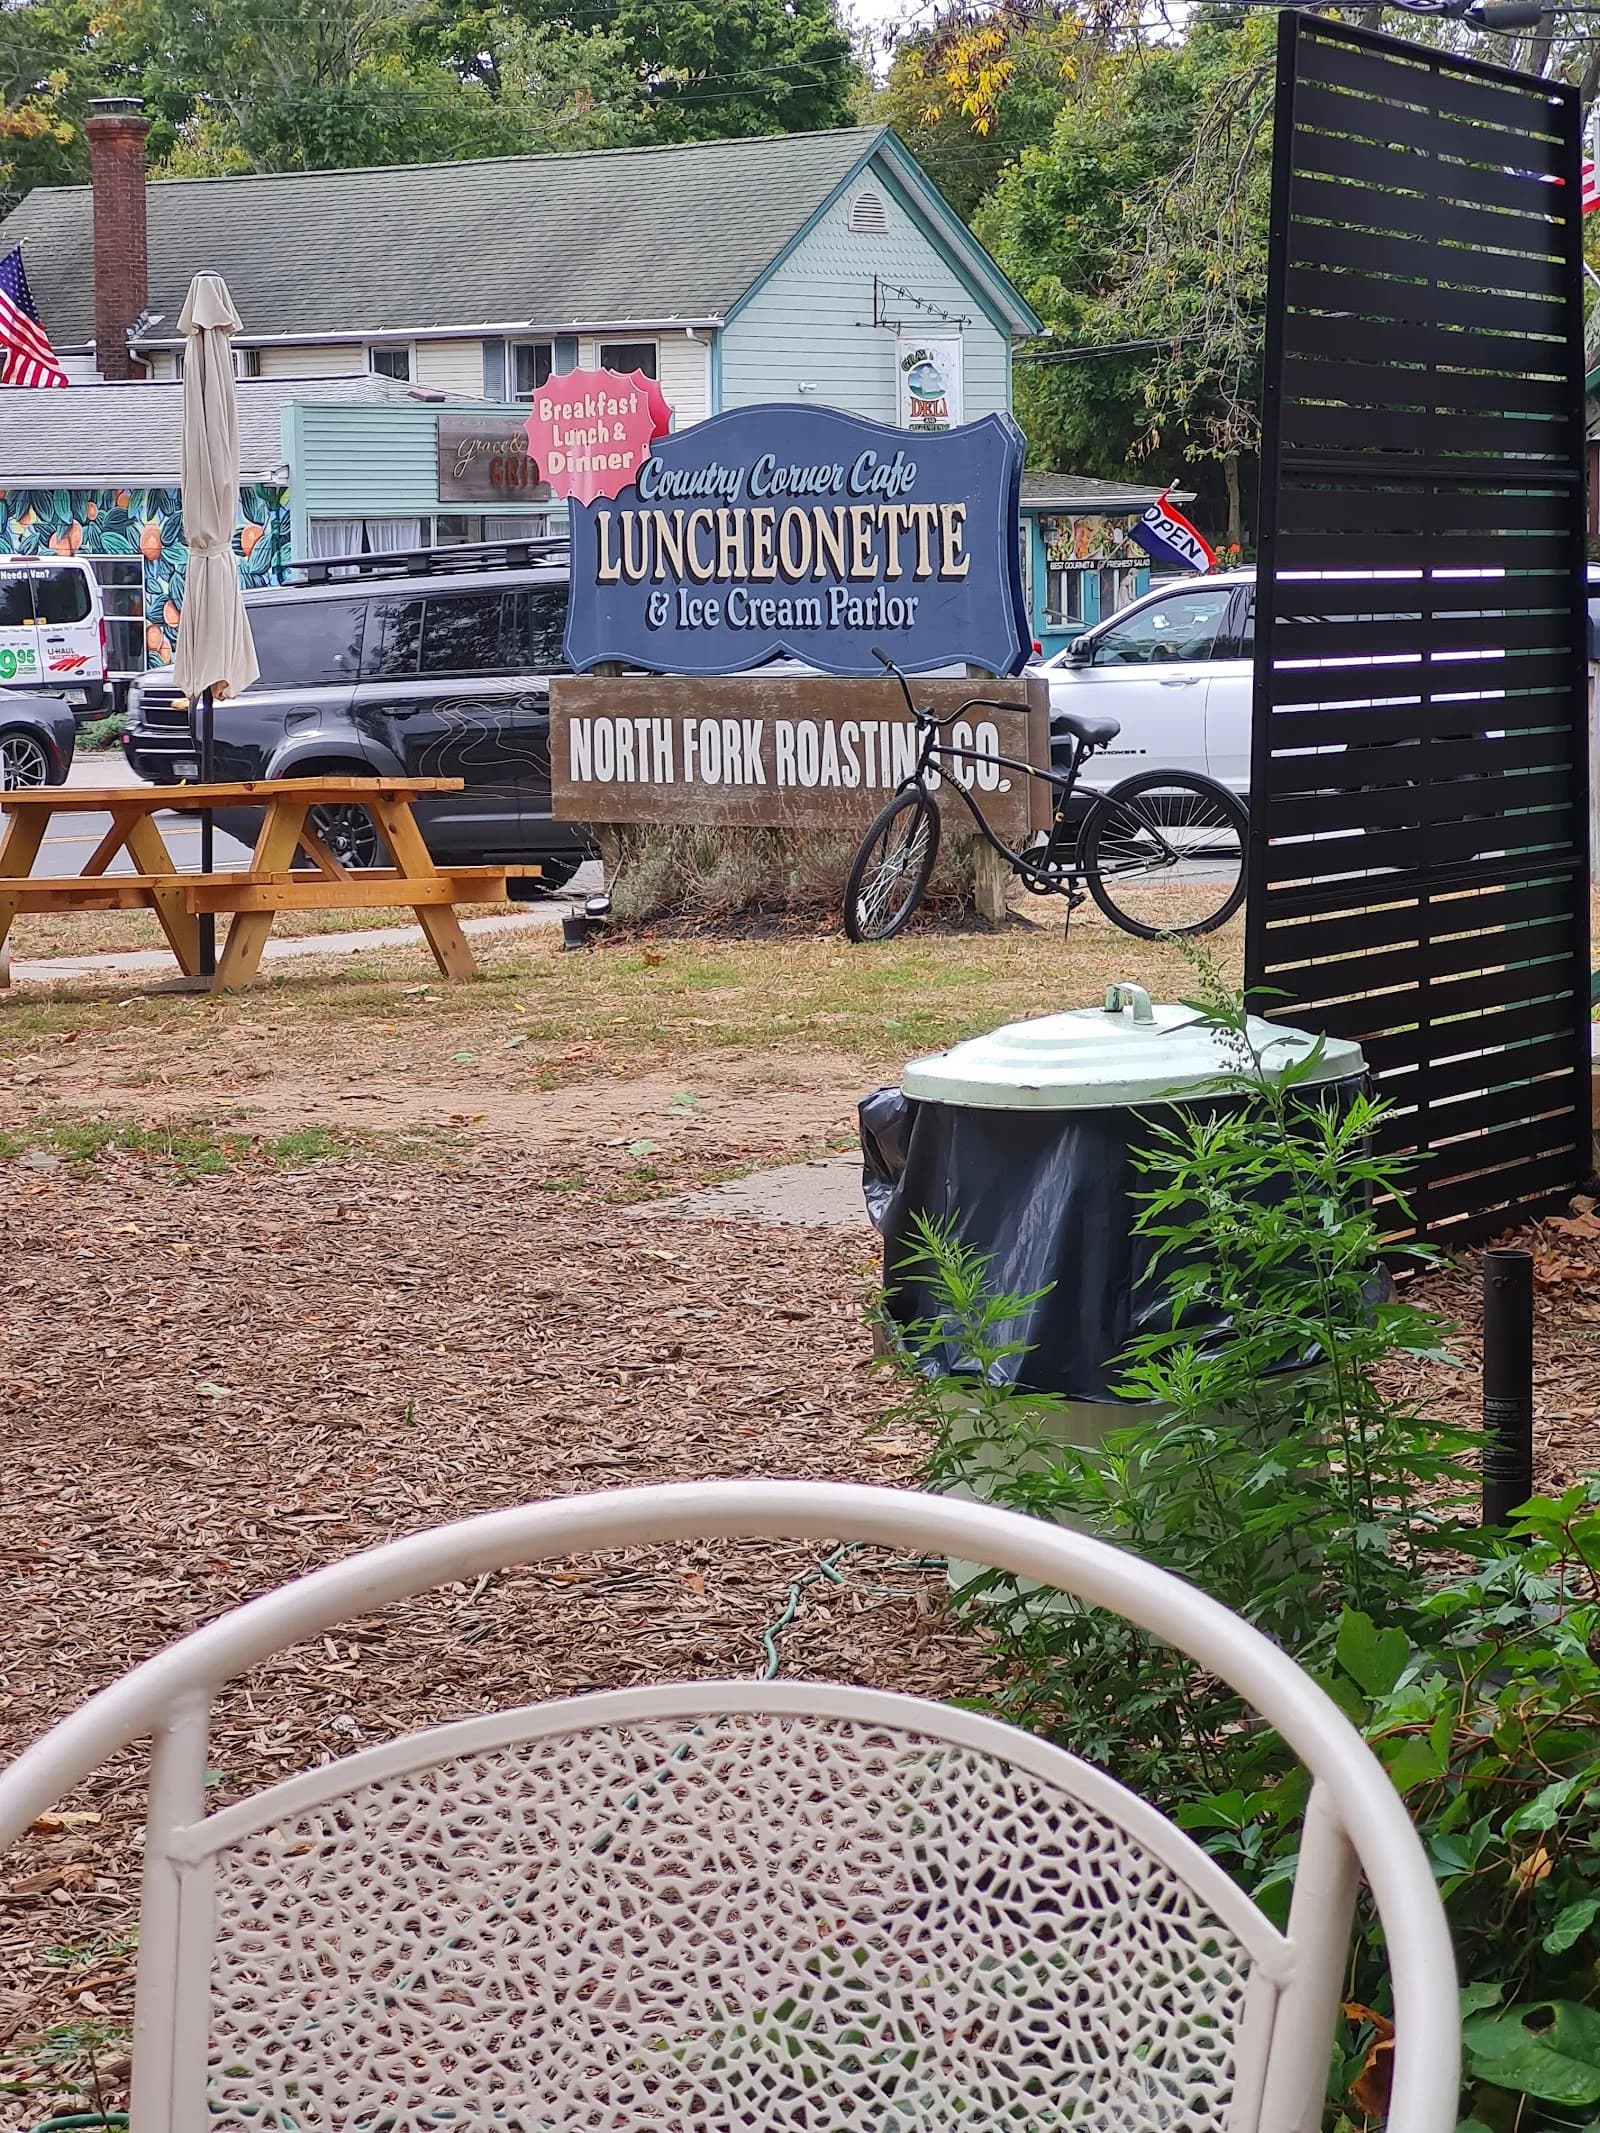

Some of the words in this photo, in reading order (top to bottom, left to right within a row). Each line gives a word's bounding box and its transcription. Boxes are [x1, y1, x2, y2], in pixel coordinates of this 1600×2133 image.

[539, 391, 638, 422] Breakfast
[911, 397, 948, 417] DELI
[552, 420, 609, 448] Lunch
[613, 422, 627, 441] &
[547, 451, 634, 475] Dinner
[639, 456, 746, 502] Country
[750, 453, 845, 496] Corner
[850, 450, 917, 498] Cafe
[597, 503, 971, 580] LUNCHEONETTE
[1142, 505, 1202, 559] OPEN
[0, 570, 22, 580] Need
[22, 571, 28, 579] a
[30, 569, 50, 579] Van?
[648, 591, 670, 627] &
[679, 587, 720, 627] Ice
[727, 586, 822, 627] Cream
[828, 585, 919, 627] Parlor
[569, 717, 674, 784] NORTH
[682, 718, 767, 785] FORK
[952, 720, 1012, 793] CO.
